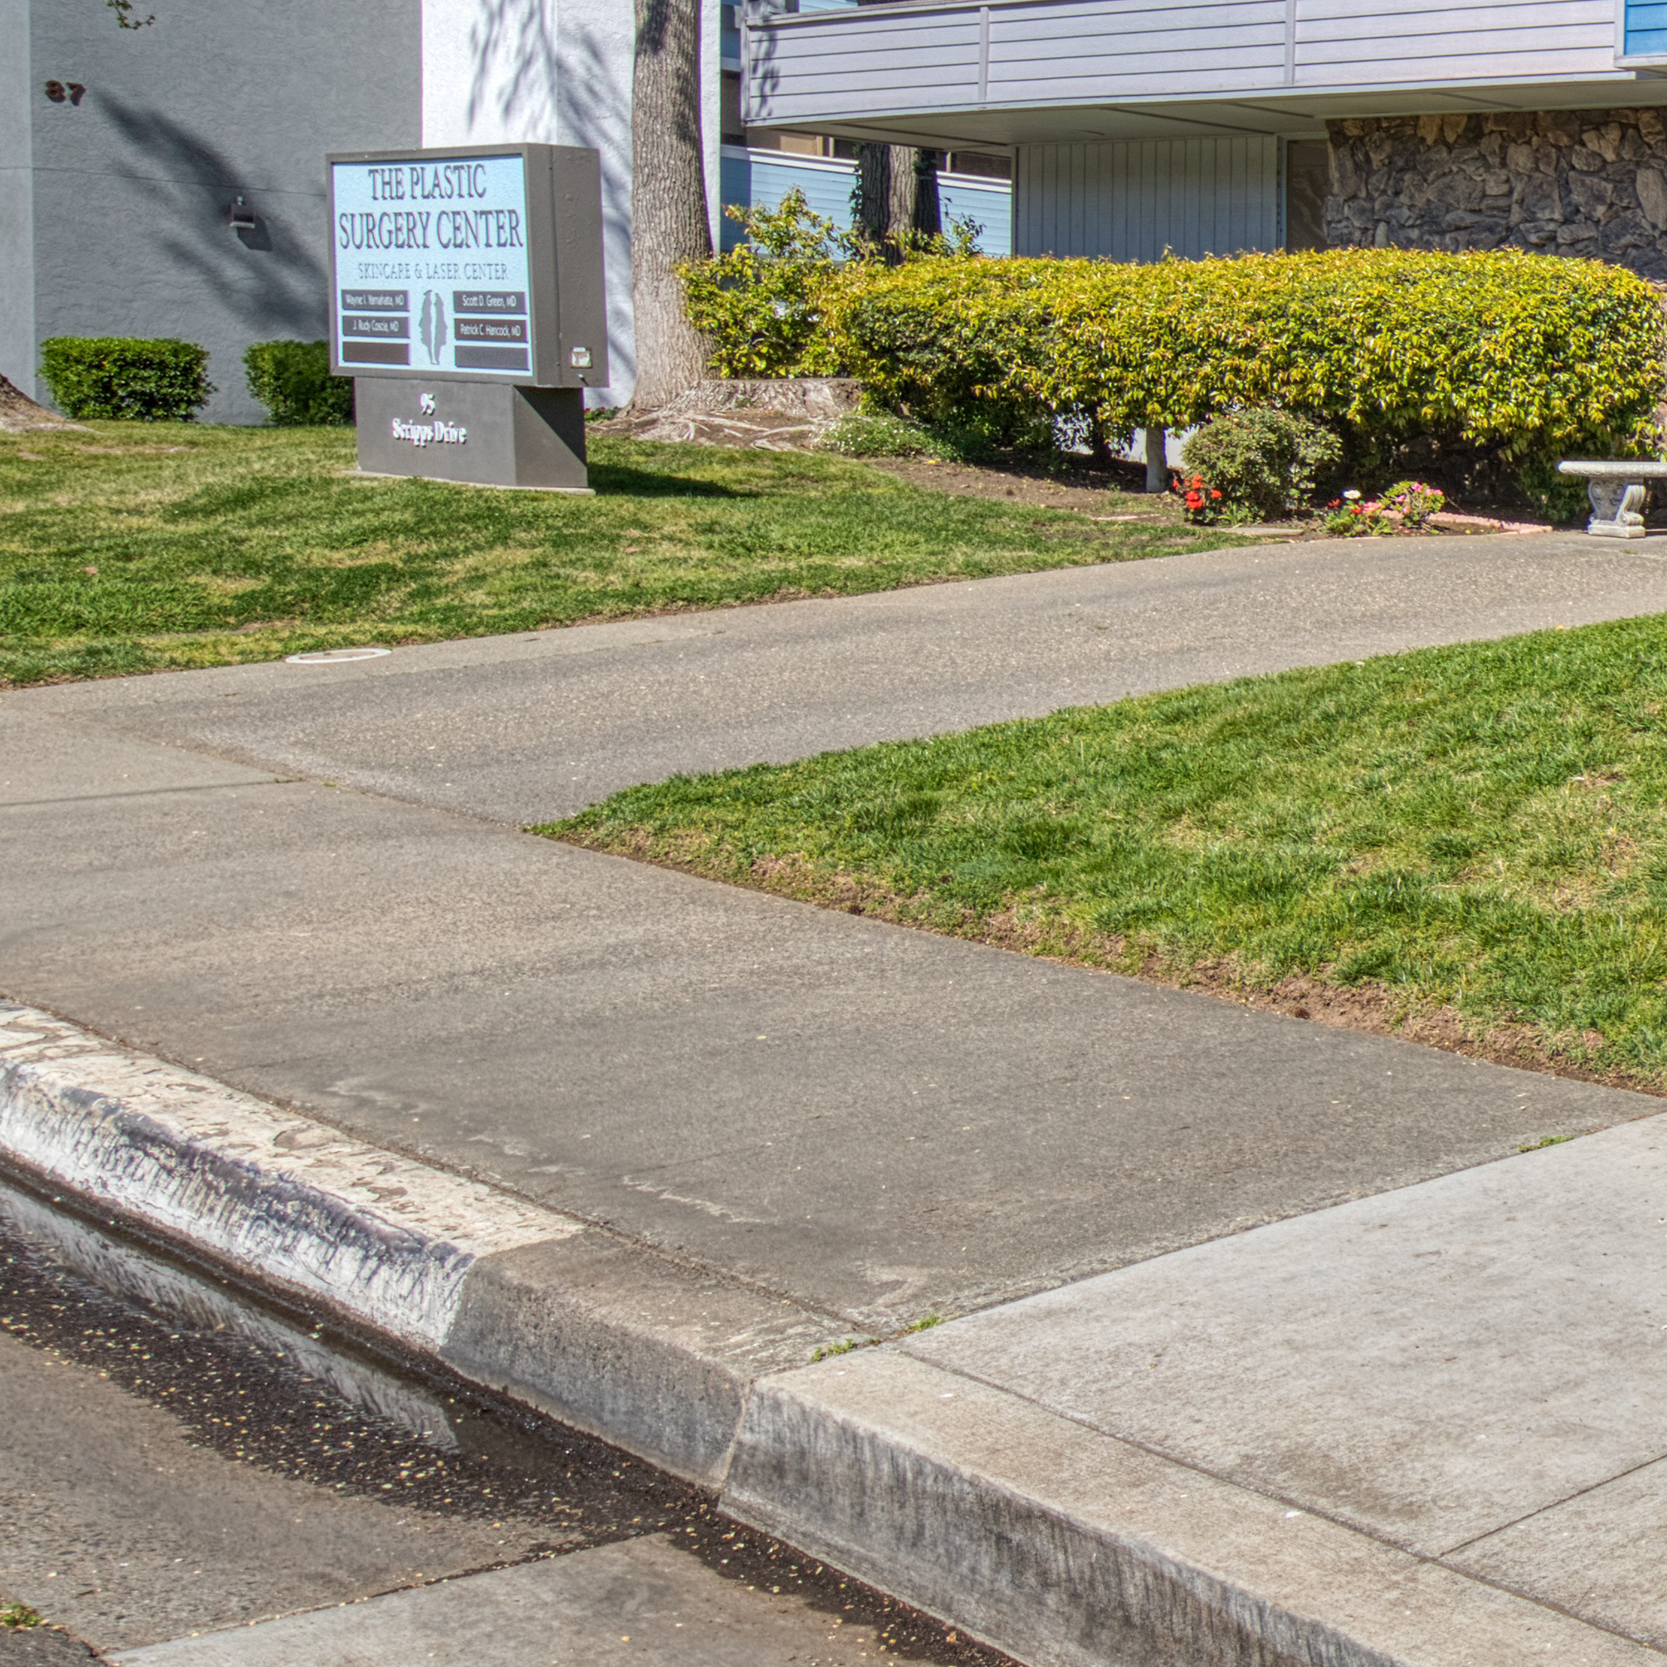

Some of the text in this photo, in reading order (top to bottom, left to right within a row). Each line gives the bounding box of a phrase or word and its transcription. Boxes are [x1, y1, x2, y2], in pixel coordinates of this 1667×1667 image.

[45, 79, 86, 107] 87
[368, 163, 487, 200] THE PLASTIC
[339, 209, 524, 250] SURGERY CENTER
[358, 262, 509, 280] SKINCARE & LASER CENTER
[462, 294, 478, 307] Scott
[486, 295, 506, 309] Green,
[507, 295, 517, 307] MD
[460, 323, 479, 336] Patrick
[511, 325, 521, 337] MD
[420, 393, 436, 415] 95
[393, 418, 467, 447] Scripps Drive
